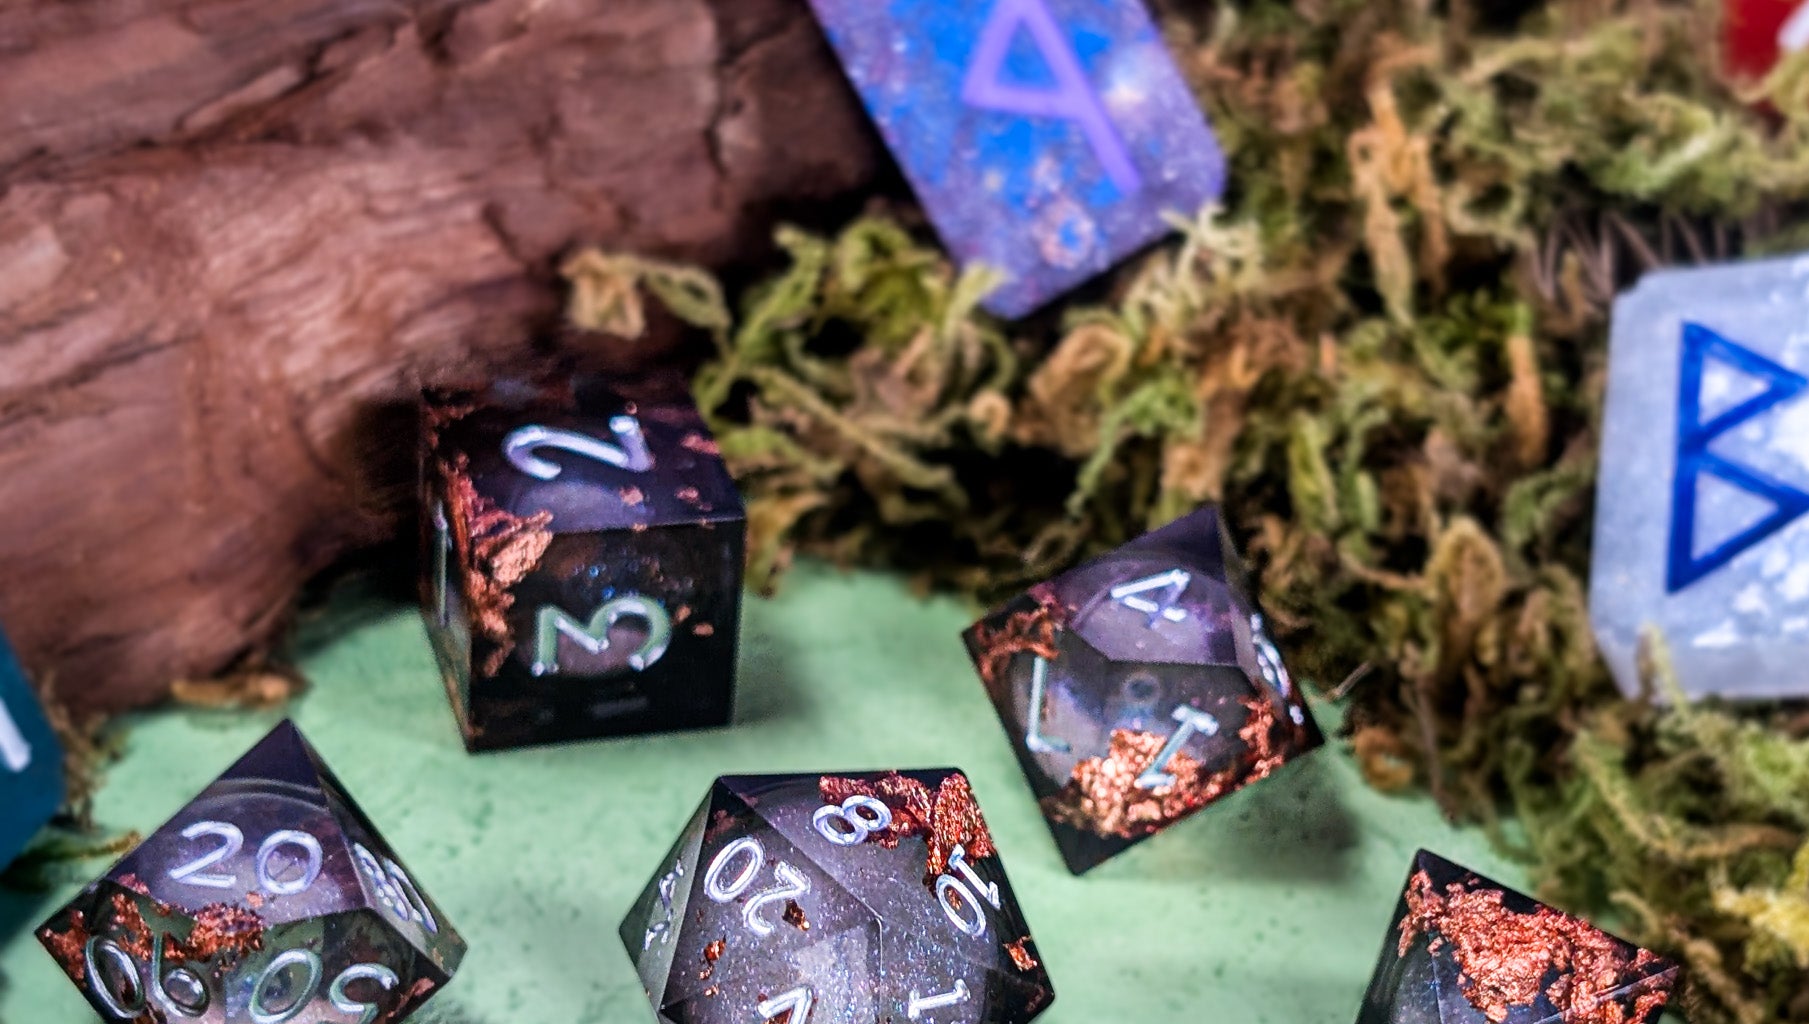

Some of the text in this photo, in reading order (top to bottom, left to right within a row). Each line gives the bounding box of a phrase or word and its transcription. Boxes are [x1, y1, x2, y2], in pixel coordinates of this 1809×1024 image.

[502, 415, 655, 480] 2
[531, 596, 672, 677] 3
[170, 821, 323, 895] 20
[812, 794, 892, 846] 8
[705, 836, 811, 936] 20
[935, 843, 1001, 938] 10
